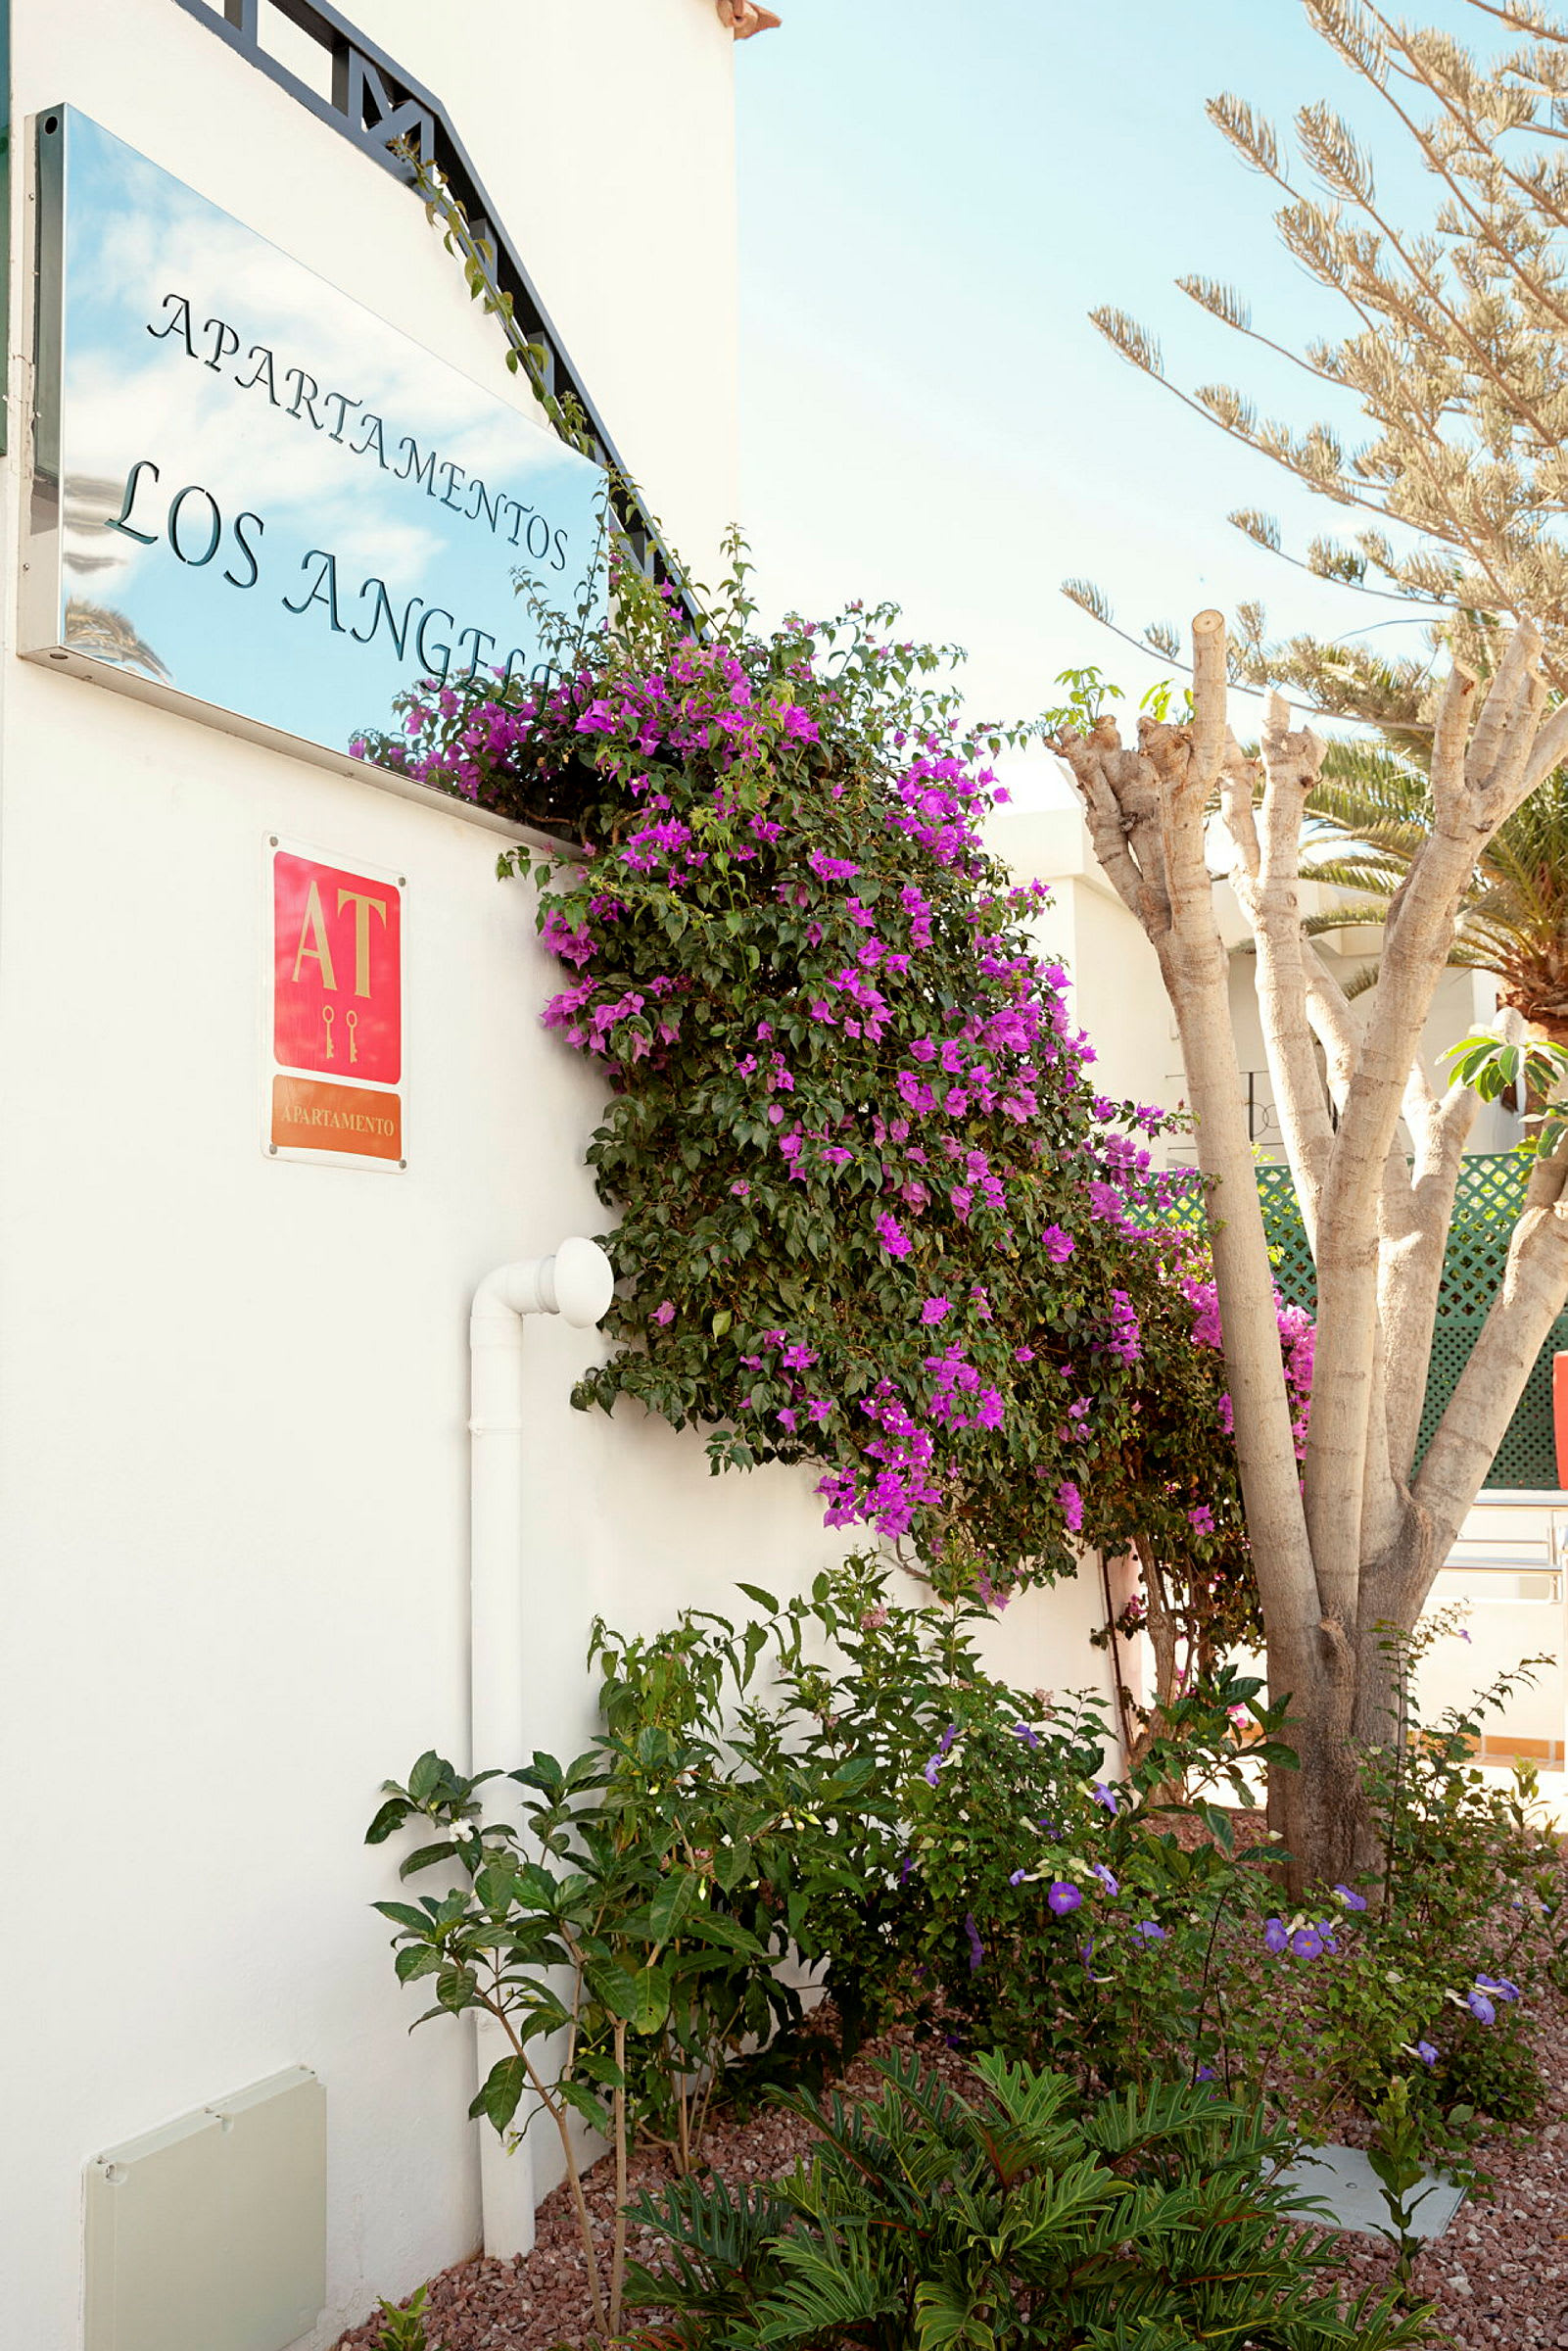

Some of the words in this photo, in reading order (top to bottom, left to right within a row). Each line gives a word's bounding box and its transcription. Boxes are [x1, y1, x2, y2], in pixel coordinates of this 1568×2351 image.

[147, 294, 568, 570] APARTAMENTOS
[105, 460, 264, 588] LOS
[292, 880, 387, 998] AT
[281, 1105, 395, 1137] APARTAMENTO
